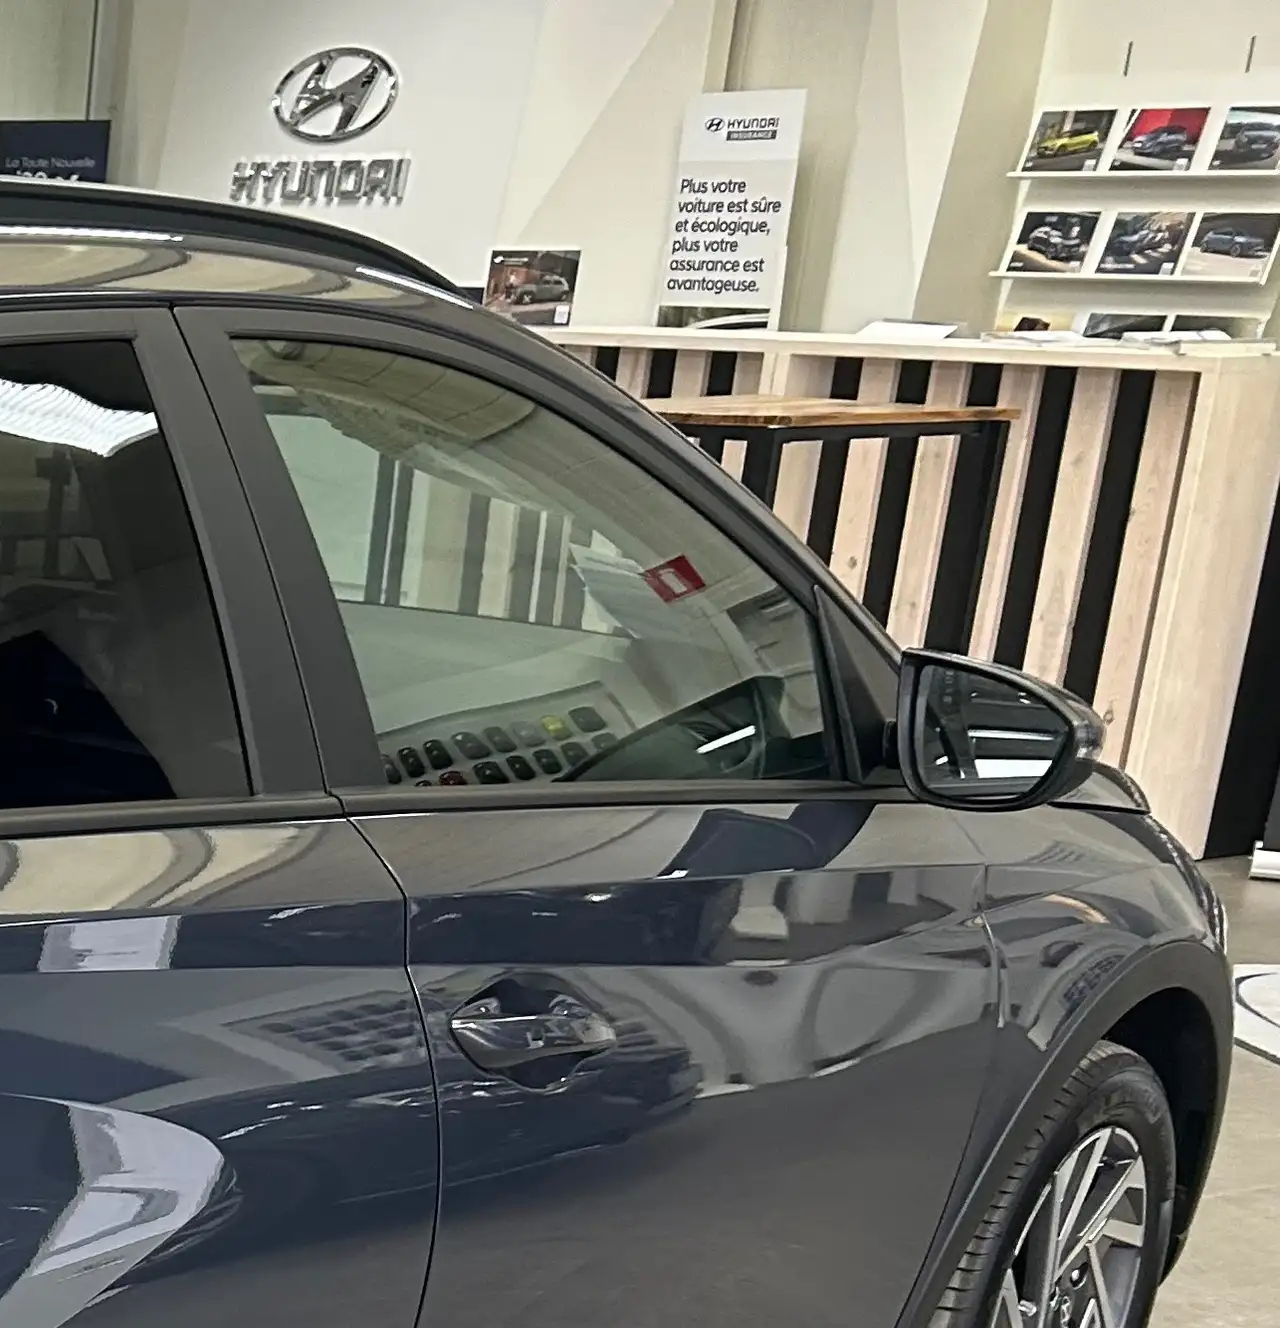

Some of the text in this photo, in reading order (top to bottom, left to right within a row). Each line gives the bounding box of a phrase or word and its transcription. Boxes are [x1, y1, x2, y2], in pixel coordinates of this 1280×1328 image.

[727, 117, 779, 129] HYUNDAI
[229, 158, 411, 207] HYUNDAI
[680, 179, 746, 194] Plus votre
[678, 197, 781, 213] voiture est sûre
[675, 216, 771, 236] et écologique,
[672, 237, 738, 255] plus votre
[669, 257, 765, 273] assurance est
[667, 277, 760, 294] avantageuse.
